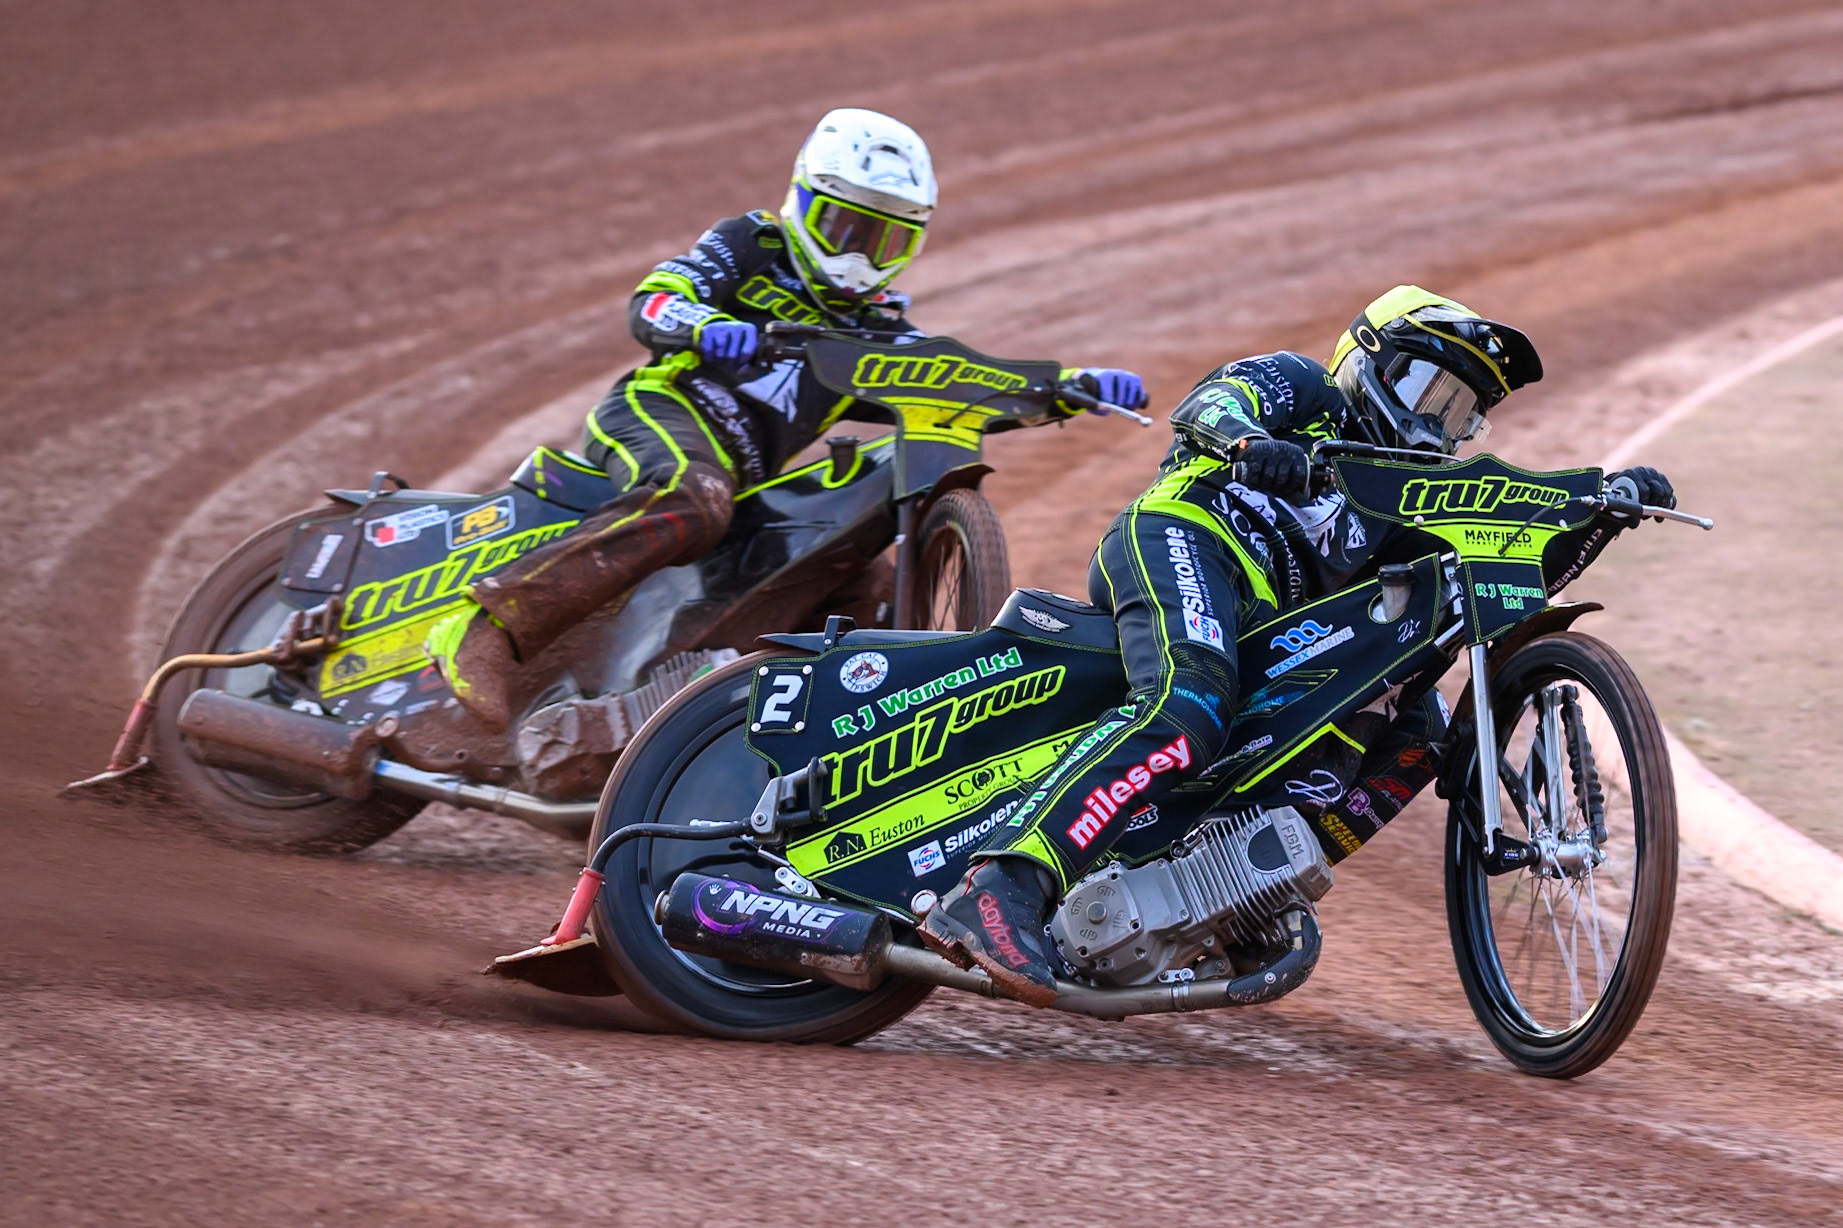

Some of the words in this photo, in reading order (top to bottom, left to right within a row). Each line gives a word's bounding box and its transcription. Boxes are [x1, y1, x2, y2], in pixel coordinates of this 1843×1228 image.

[852, 354, 1028, 390] tru7group
[1399, 476, 1570, 516] tru7group
[1164, 526, 1205, 614] Silkolene
[1475, 583, 1488, 597] R
[1488, 584, 1496, 598] J
[1497, 584, 1544, 599] Warren
[1503, 598, 1524, 610] Ltd
[760, 675, 805, 723] 2
[831, 714, 859, 740] R
[852, 705, 877, 731] J
[877, 664, 976, 718] Warren
[975, 647, 1024, 678] Ltd
[1172, 687, 1223, 731] THERMOHOME
[822, 665, 1067, 811] tru7group
[944, 757, 1024, 805] SCOTT
[993, 776, 1015, 791] GROU
[1066, 734, 1192, 850] milesey
[829, 834, 866, 864] R.N.
[869, 813, 926, 848] Euston
[944, 798, 1022, 854] Silkolen
[1128, 808, 1158, 829] OOLS
[913, 850, 940, 867] FUCHS
[721, 890, 846, 930] NPNG
[763, 922, 811, 938] MEDIA
[977, 891, 1031, 968] daytona
